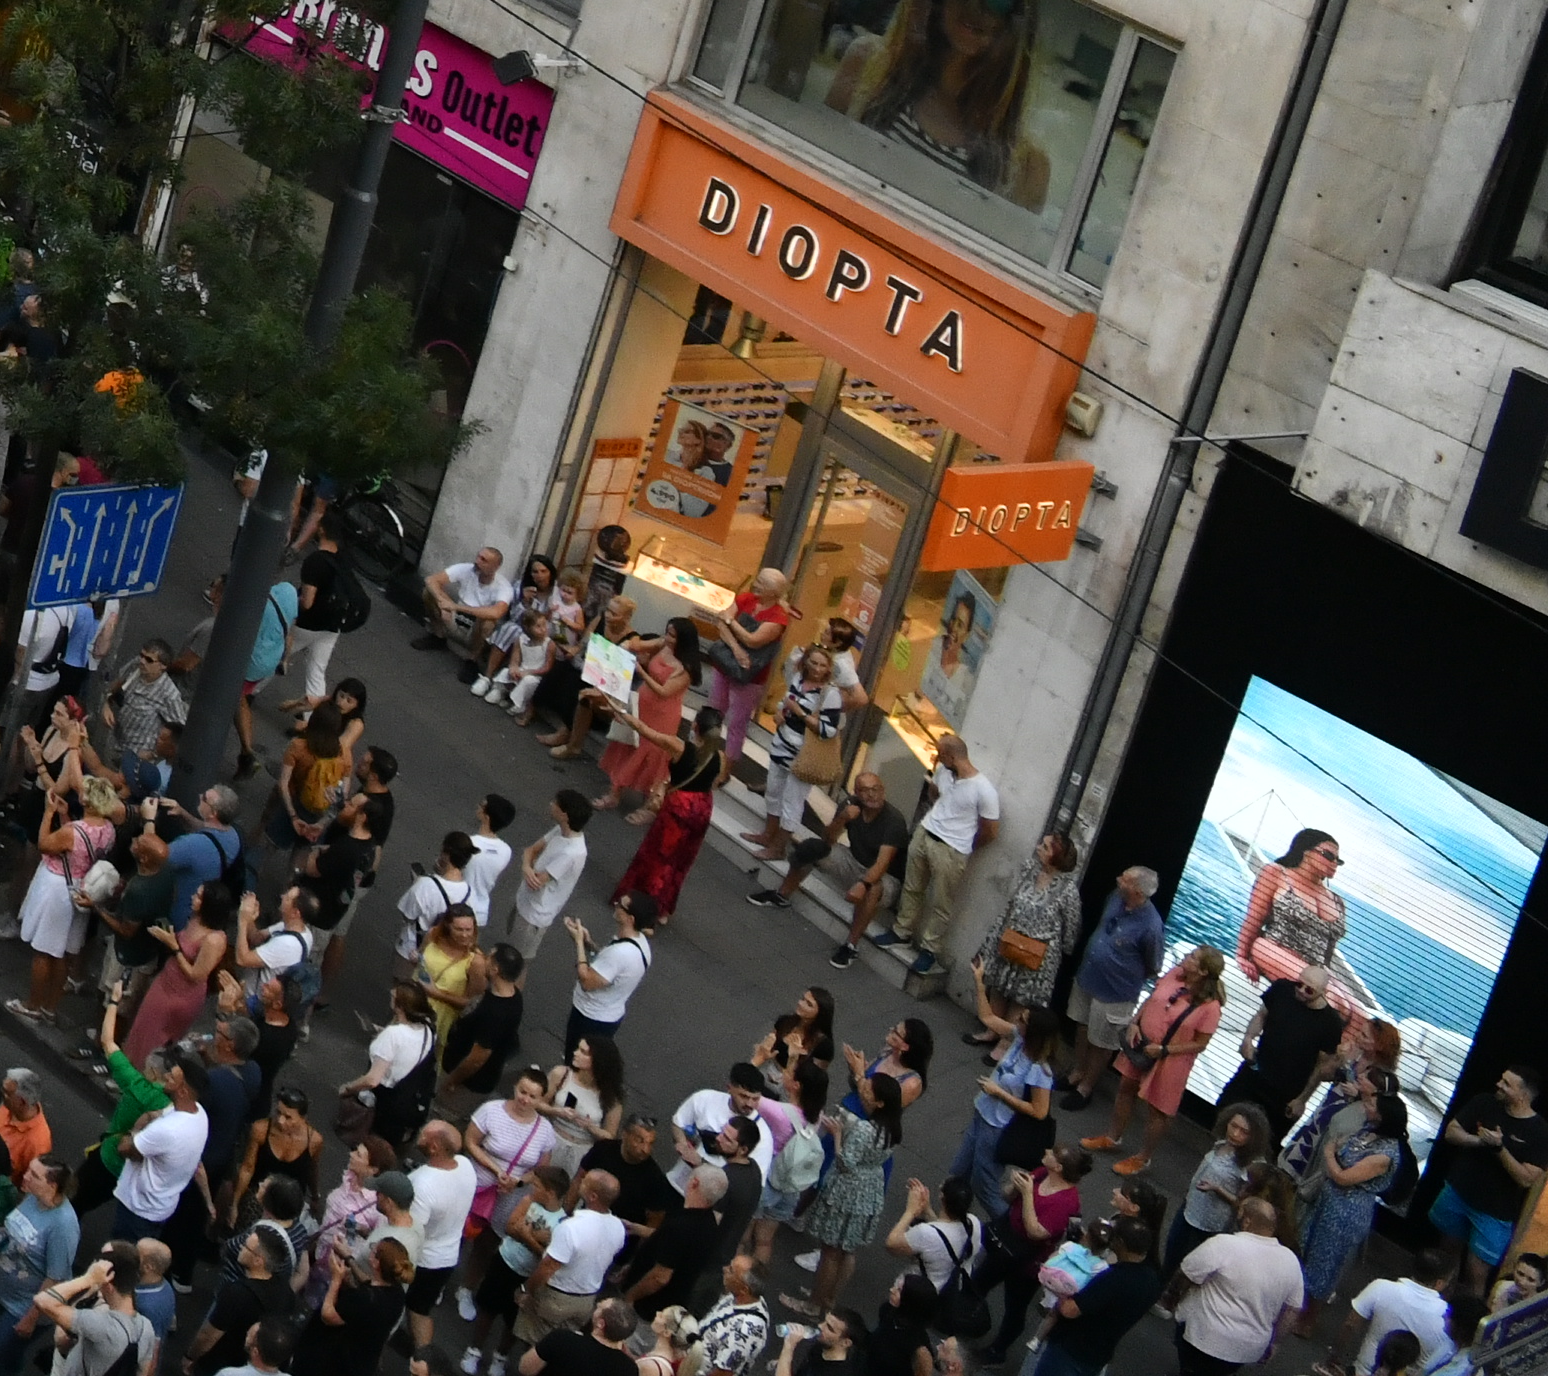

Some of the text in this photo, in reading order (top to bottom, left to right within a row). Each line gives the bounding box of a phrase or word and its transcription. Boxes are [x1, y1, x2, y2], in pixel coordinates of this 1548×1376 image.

[441, 70, 543, 159] Outlet
[697, 175, 965, 374] DIOPTA
[950, 500, 1072, 537] DIOPTA
